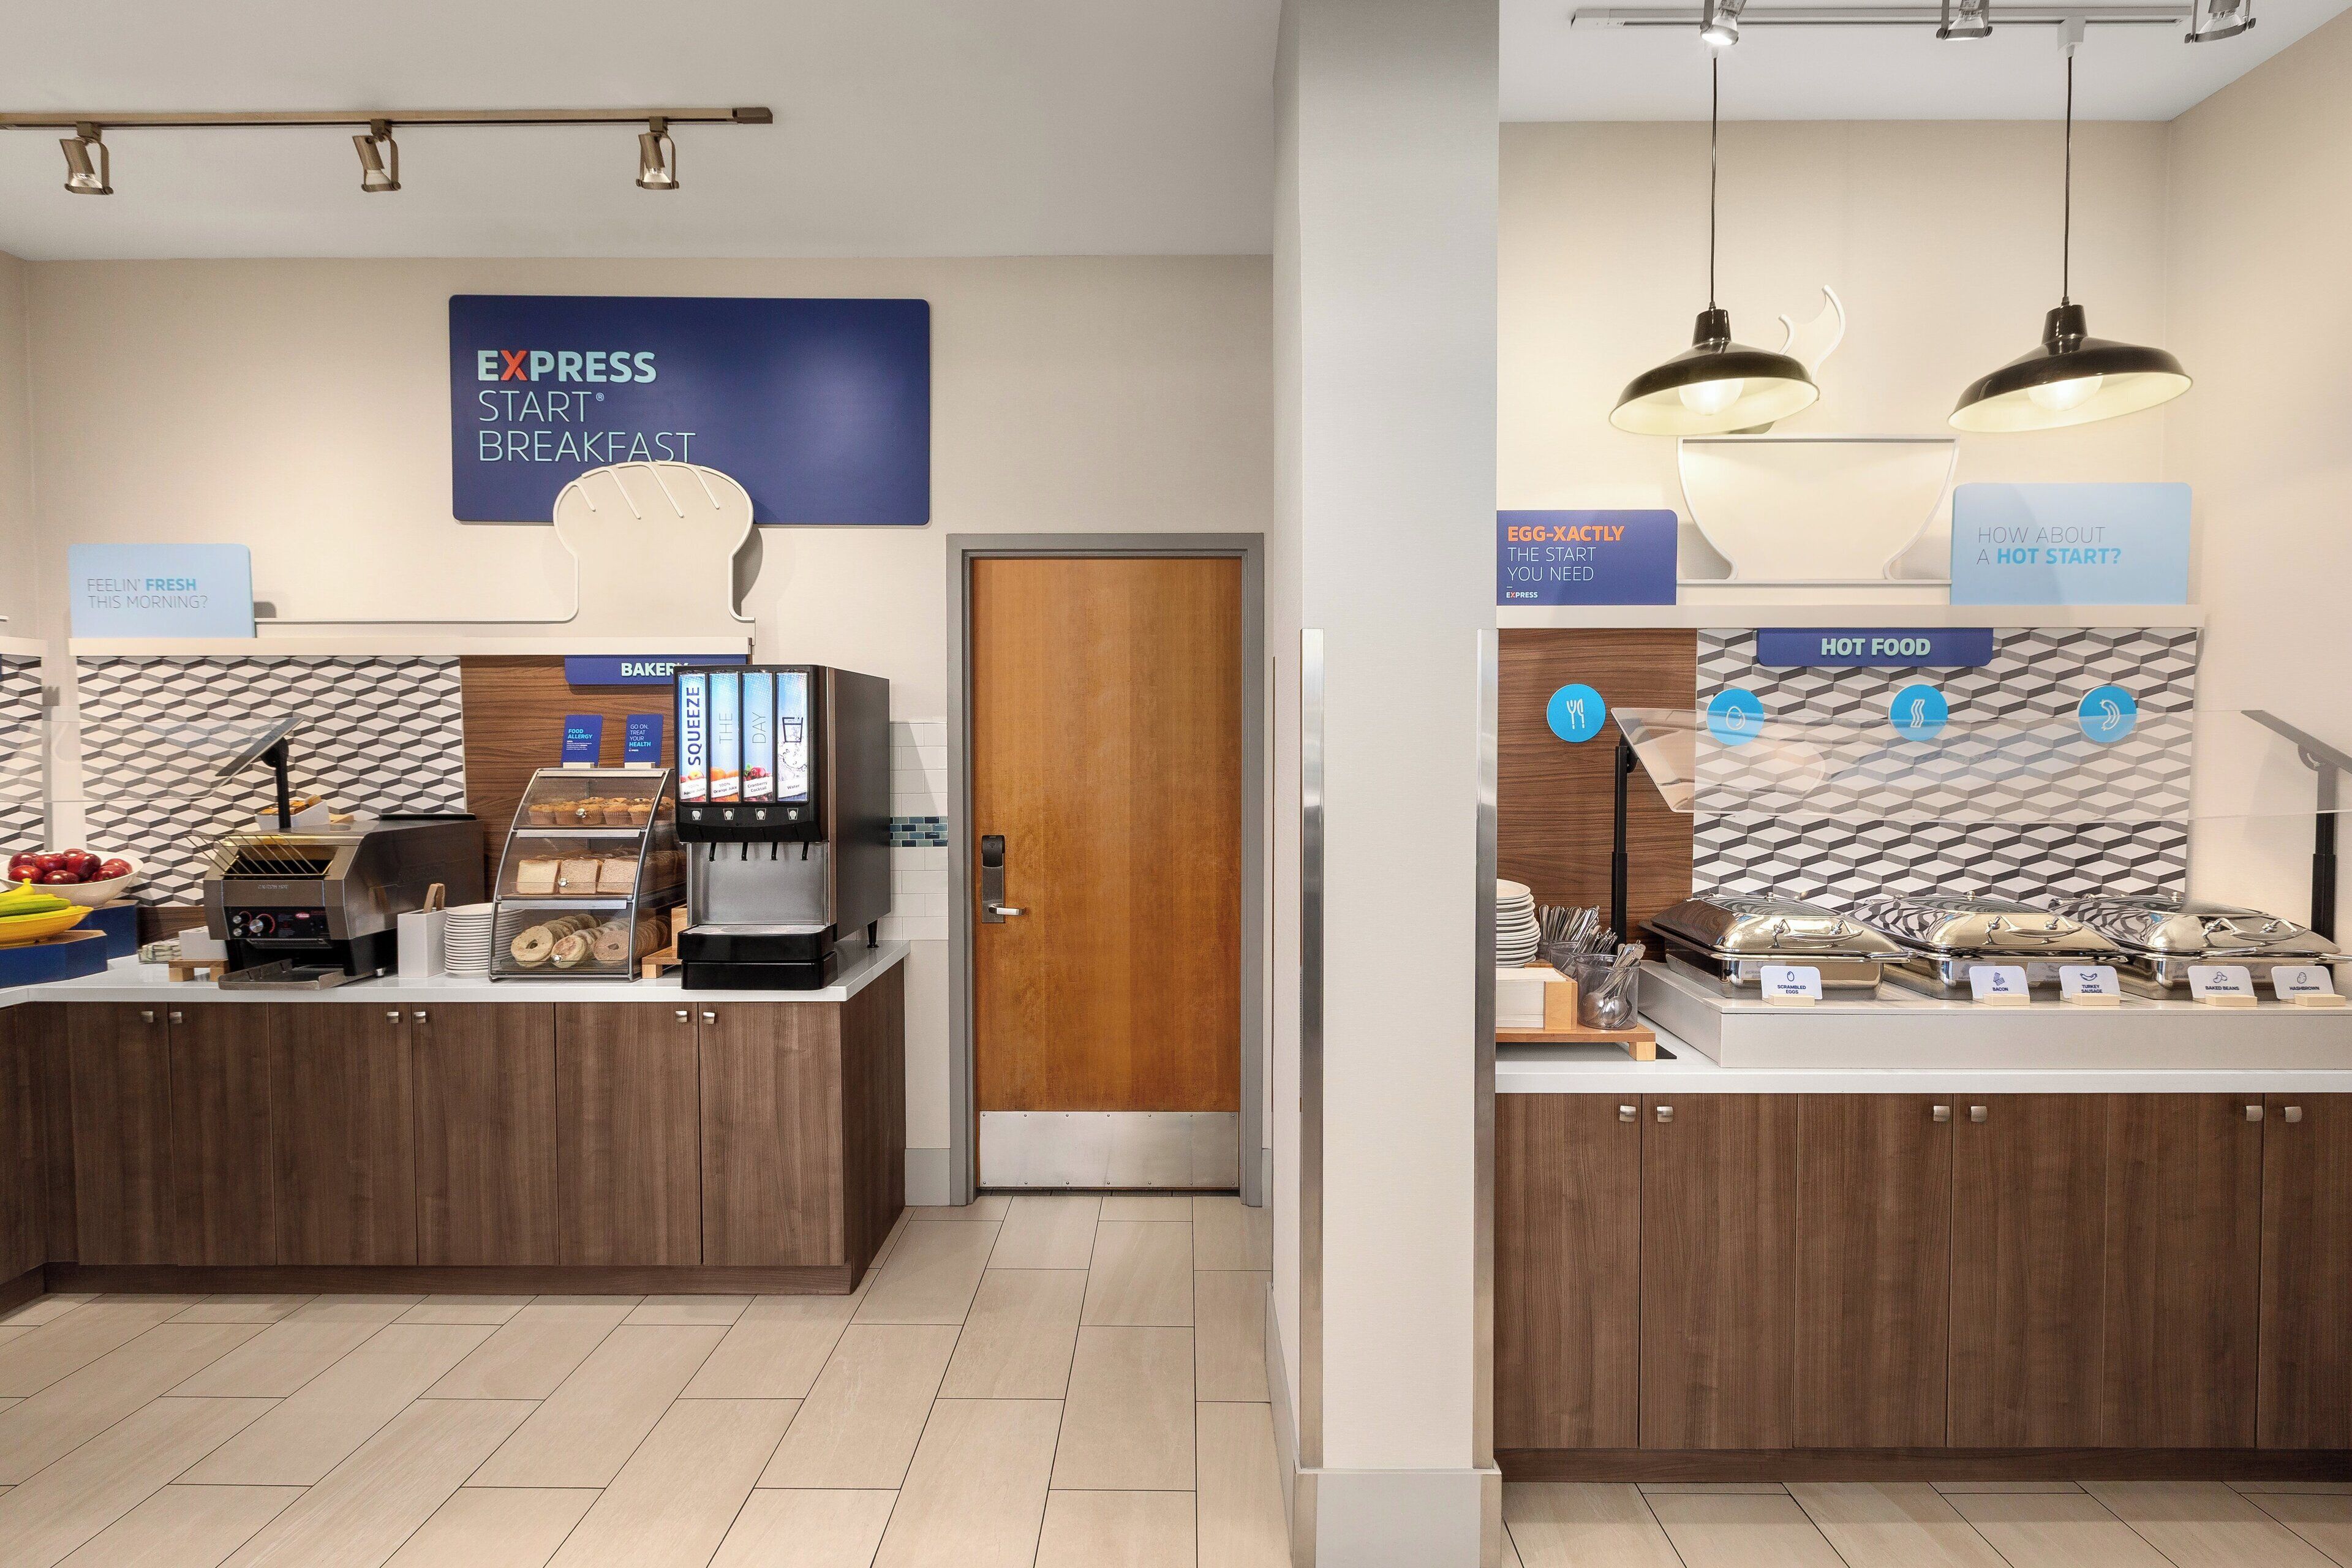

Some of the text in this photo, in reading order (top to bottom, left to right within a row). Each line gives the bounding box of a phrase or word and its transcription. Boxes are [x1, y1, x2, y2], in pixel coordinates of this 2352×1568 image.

[477, 350, 657, 383] EXPRESS
[479, 430, 696, 463] BREAKFAST
[1507, 526, 1625, 542] EGG-XACTLY
[1978, 527, 2106, 543] HOW ABOUT
[1507, 547, 1597, 562] THE START
[1976, 548, 2122, 565] A HOT START?
[1507, 567, 1594, 581] YOU NEED
[145, 578, 197, 592] FRESH
[87, 595, 208, 609] THIS MORNING?
[1821, 638, 1931, 656] HOT FOOD
[621, 663, 688, 676] BAKER
[686, 687, 702, 766] SQUEEZE
[719, 713, 733, 744] THE
[752, 712, 766, 744] DAY
